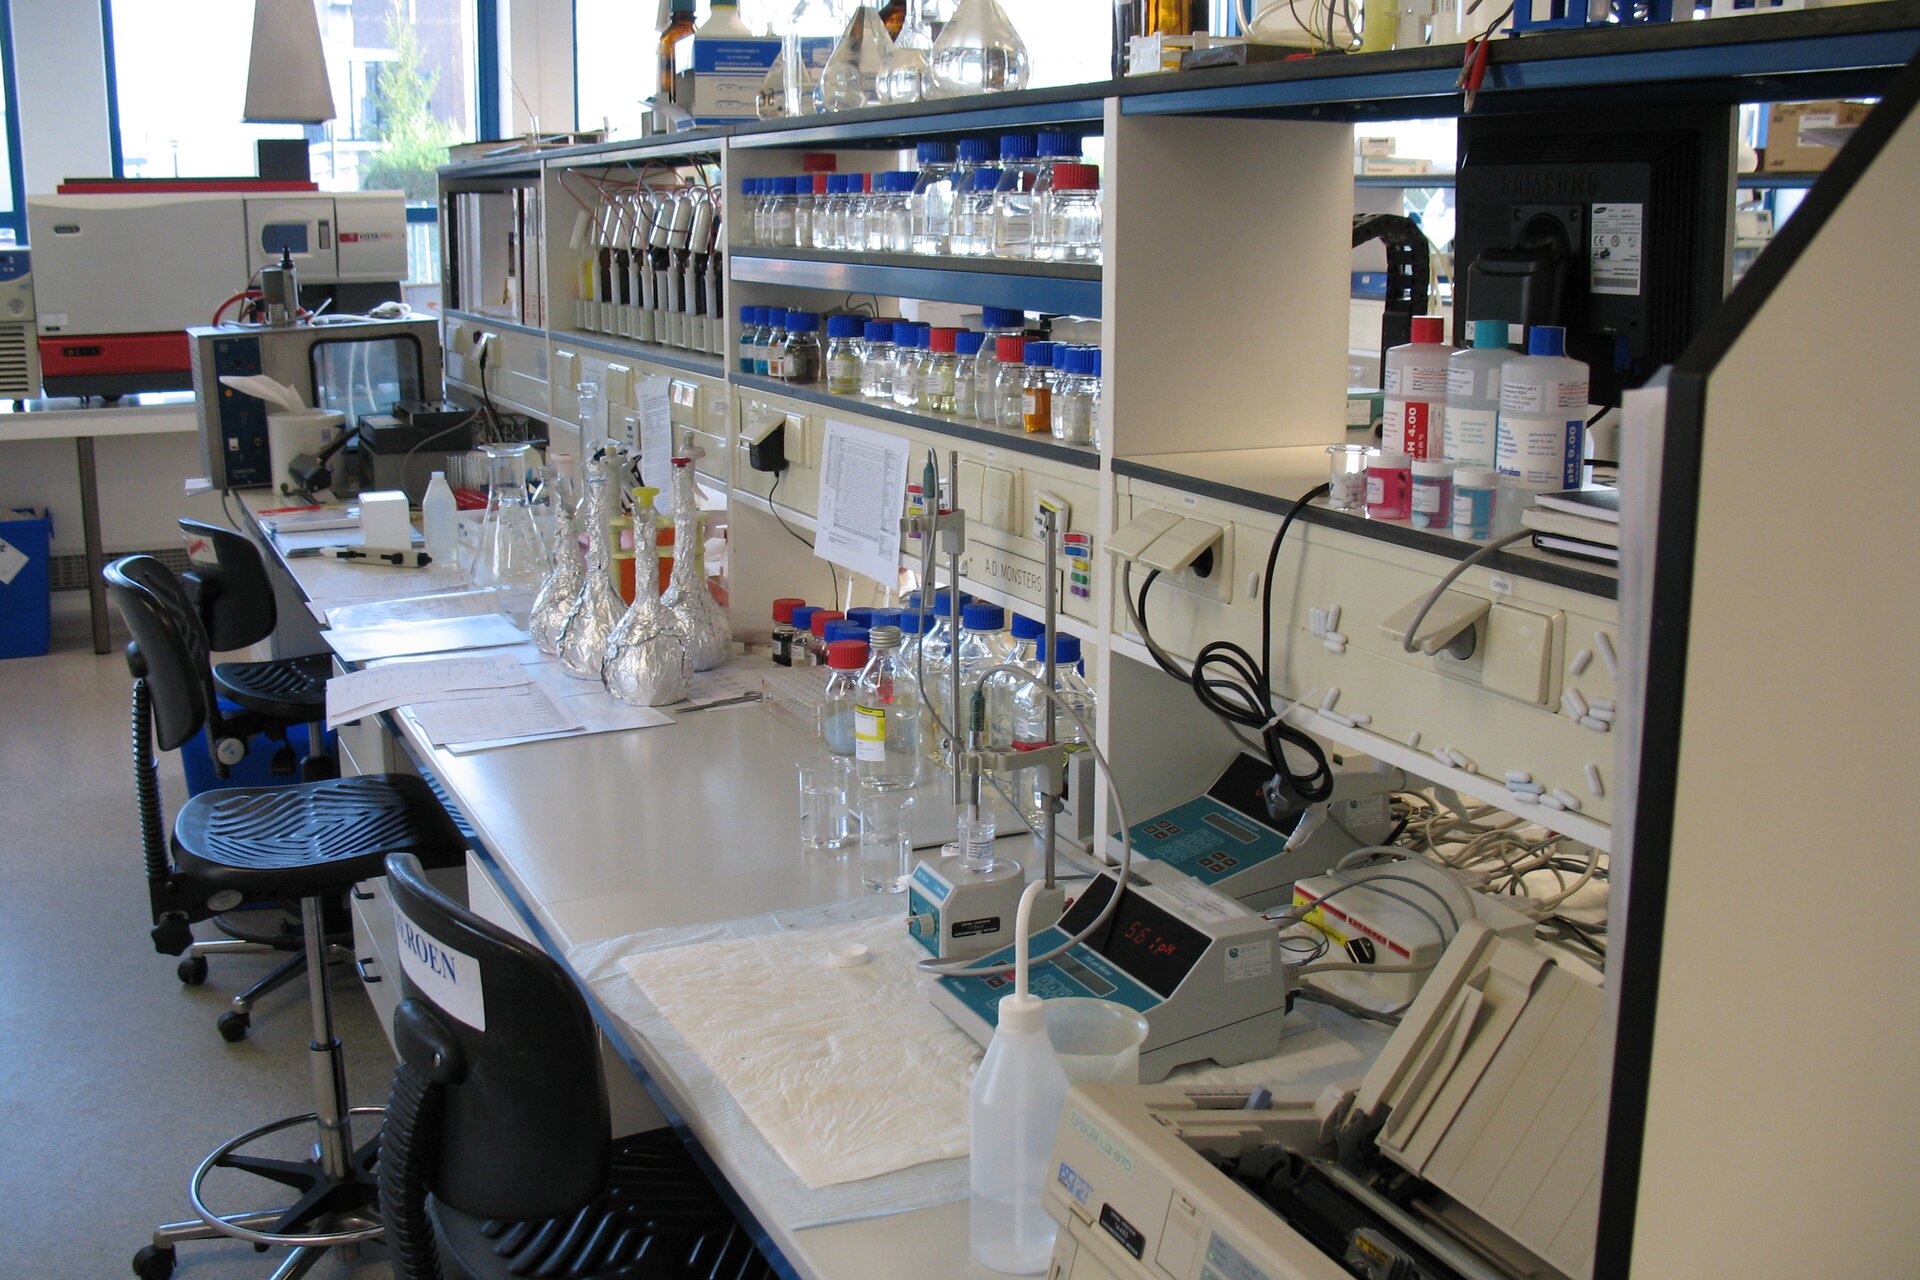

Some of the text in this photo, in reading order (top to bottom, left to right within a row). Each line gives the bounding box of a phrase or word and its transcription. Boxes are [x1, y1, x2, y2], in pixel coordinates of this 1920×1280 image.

[1502, 172, 1599, 195] SAMSUNG
[1408, 407, 1417, 437] 4.00
[1567, 426, 1577, 483] pH 9.00
[1001, 564, 1042, 593] MONSTERS
[1070, 1109, 1099, 1144] EPSON
